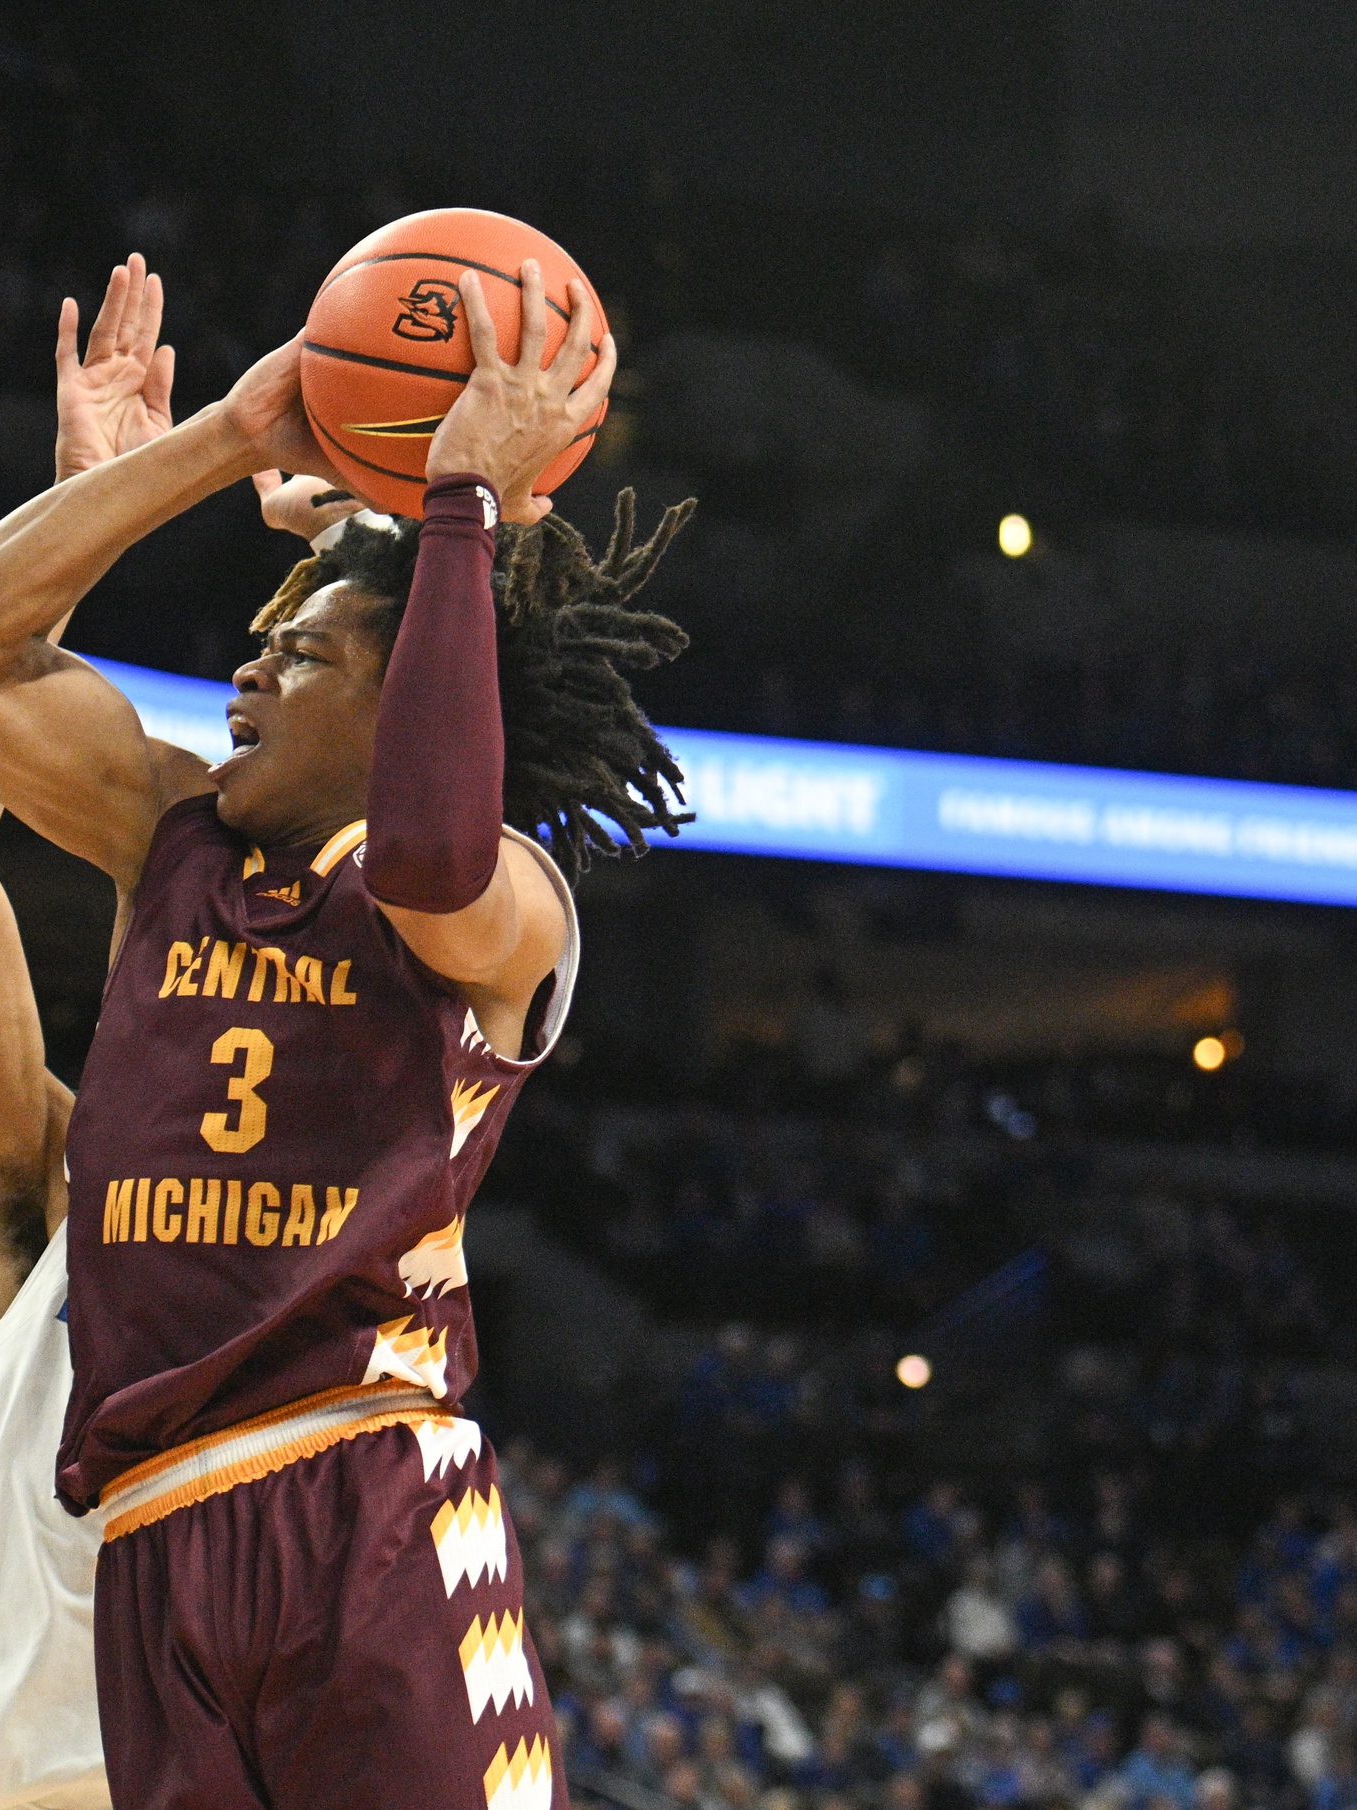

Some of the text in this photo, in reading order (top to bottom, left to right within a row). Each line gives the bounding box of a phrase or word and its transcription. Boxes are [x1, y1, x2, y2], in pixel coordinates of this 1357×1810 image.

[158, 936, 357, 1005] CENTRAL
[199, 1026, 274, 1154] 3
[102, 1177, 359, 1248] MICHIGAN
